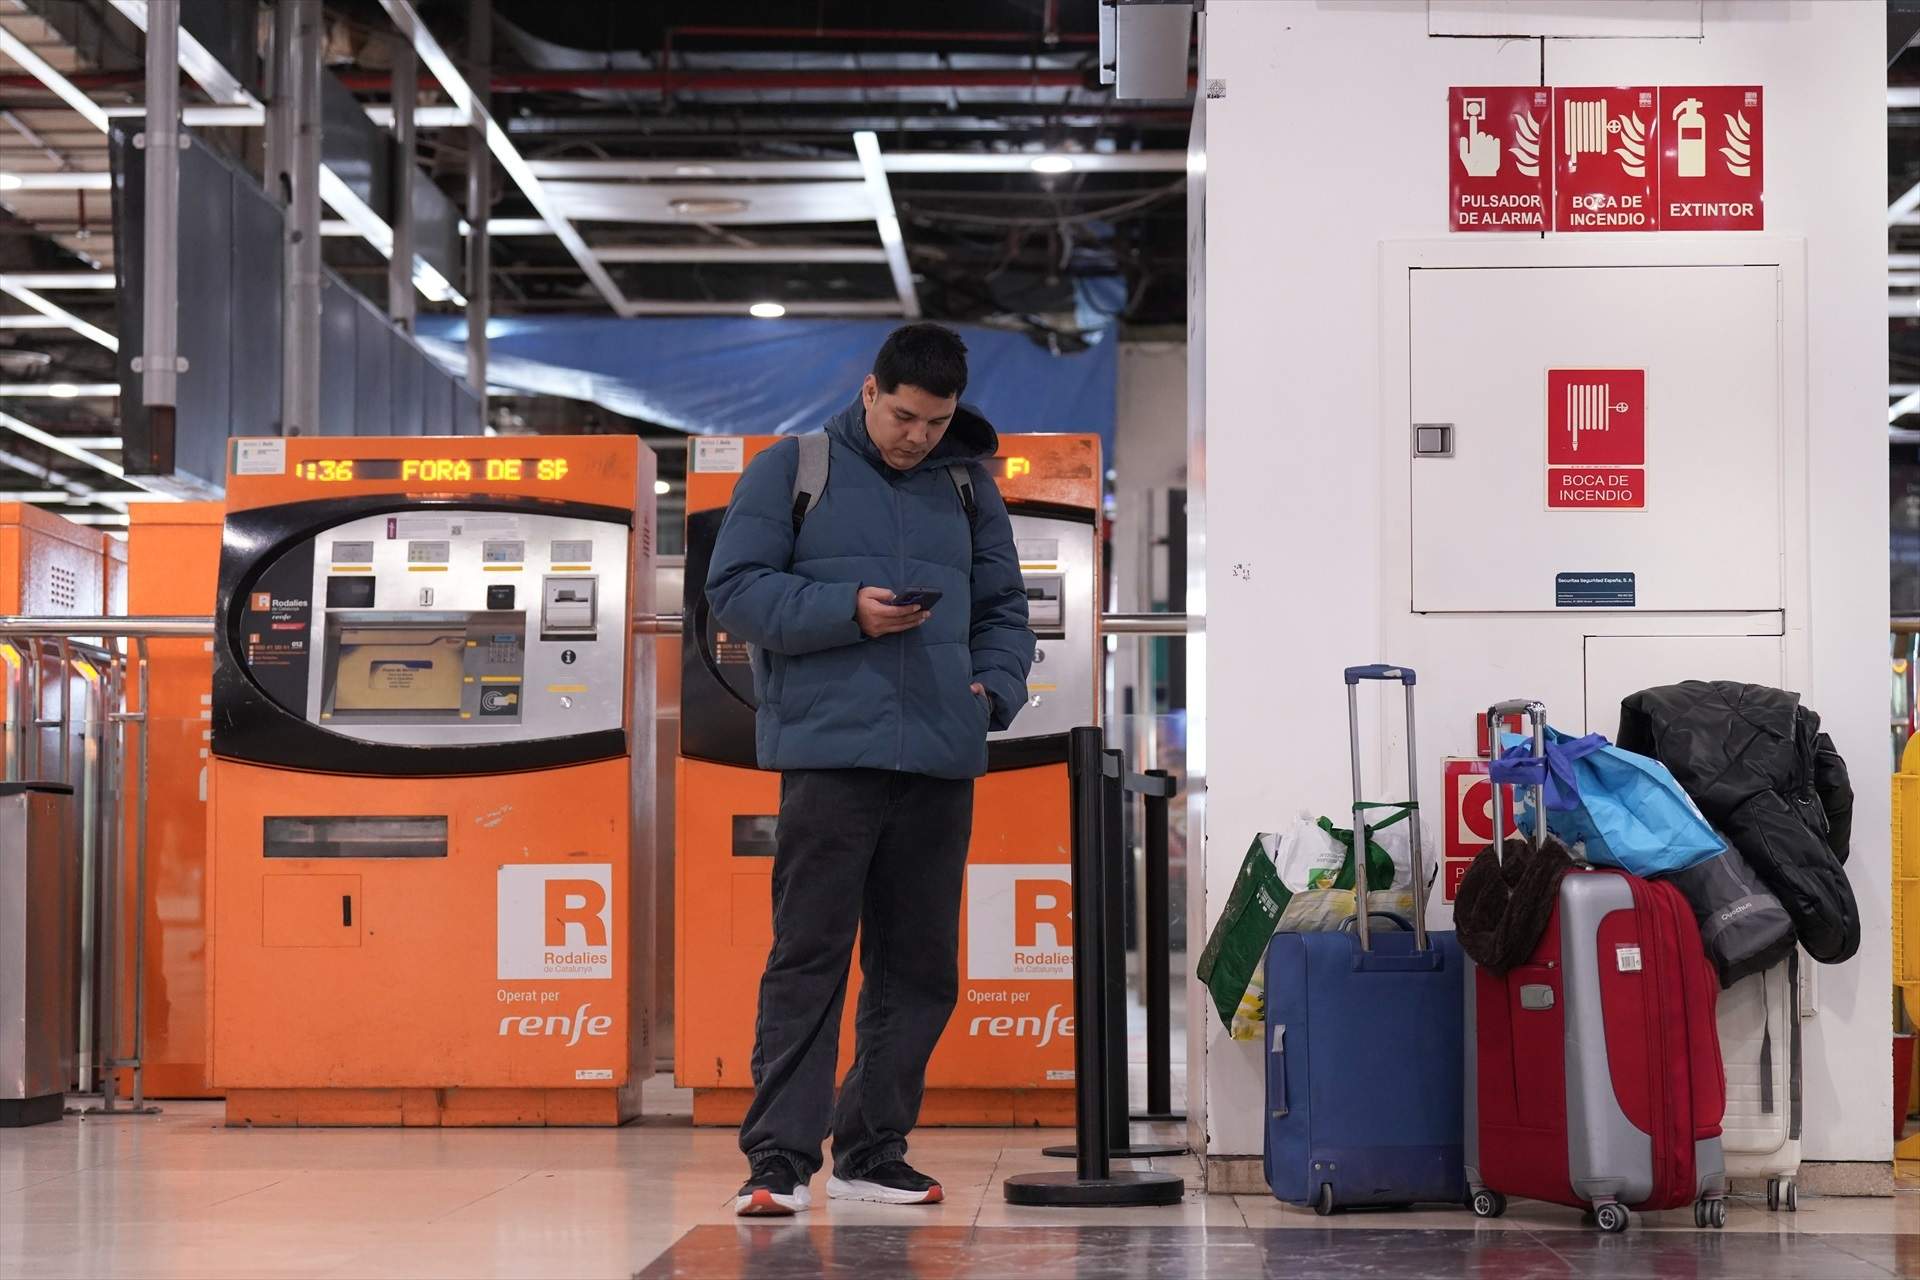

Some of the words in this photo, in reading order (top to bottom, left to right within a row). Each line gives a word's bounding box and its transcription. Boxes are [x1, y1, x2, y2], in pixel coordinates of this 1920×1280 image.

[1461, 195, 1541, 208] PULSADOR
[1572, 195, 1617, 209] BOCA
[1621, 195, 1643, 208] DE
[1670, 203, 1754, 217] EXTINTOR
[1459, 212, 1480, 225] DE
[1482, 212, 1543, 225] ALARMA
[1570, 213, 1645, 226] INCENDIO
[402, 459, 472, 481] FORA
[486, 459, 522, 480] DE
[1562, 475, 1605, 486] BOCA
[1608, 475, 1629, 486] DE
[1559, 489, 1632, 501] INCENDIO
[271, 599, 308, 607] Rodalies
[545, 879, 608, 946] R
[1015, 879, 1073, 946] R
[544, 952, 608, 964] Rodalies
[544, 965, 553, 973] de
[555, 965, 593, 974] Catalunya
[496, 989, 537, 1004] Operat
[541, 990, 560, 1004] per
[967, 989, 1007, 1004] Operat
[1011, 990, 1031, 1004] per
[498, 1003, 612, 1047] renfe
[969, 1003, 1074, 1048] renfe
